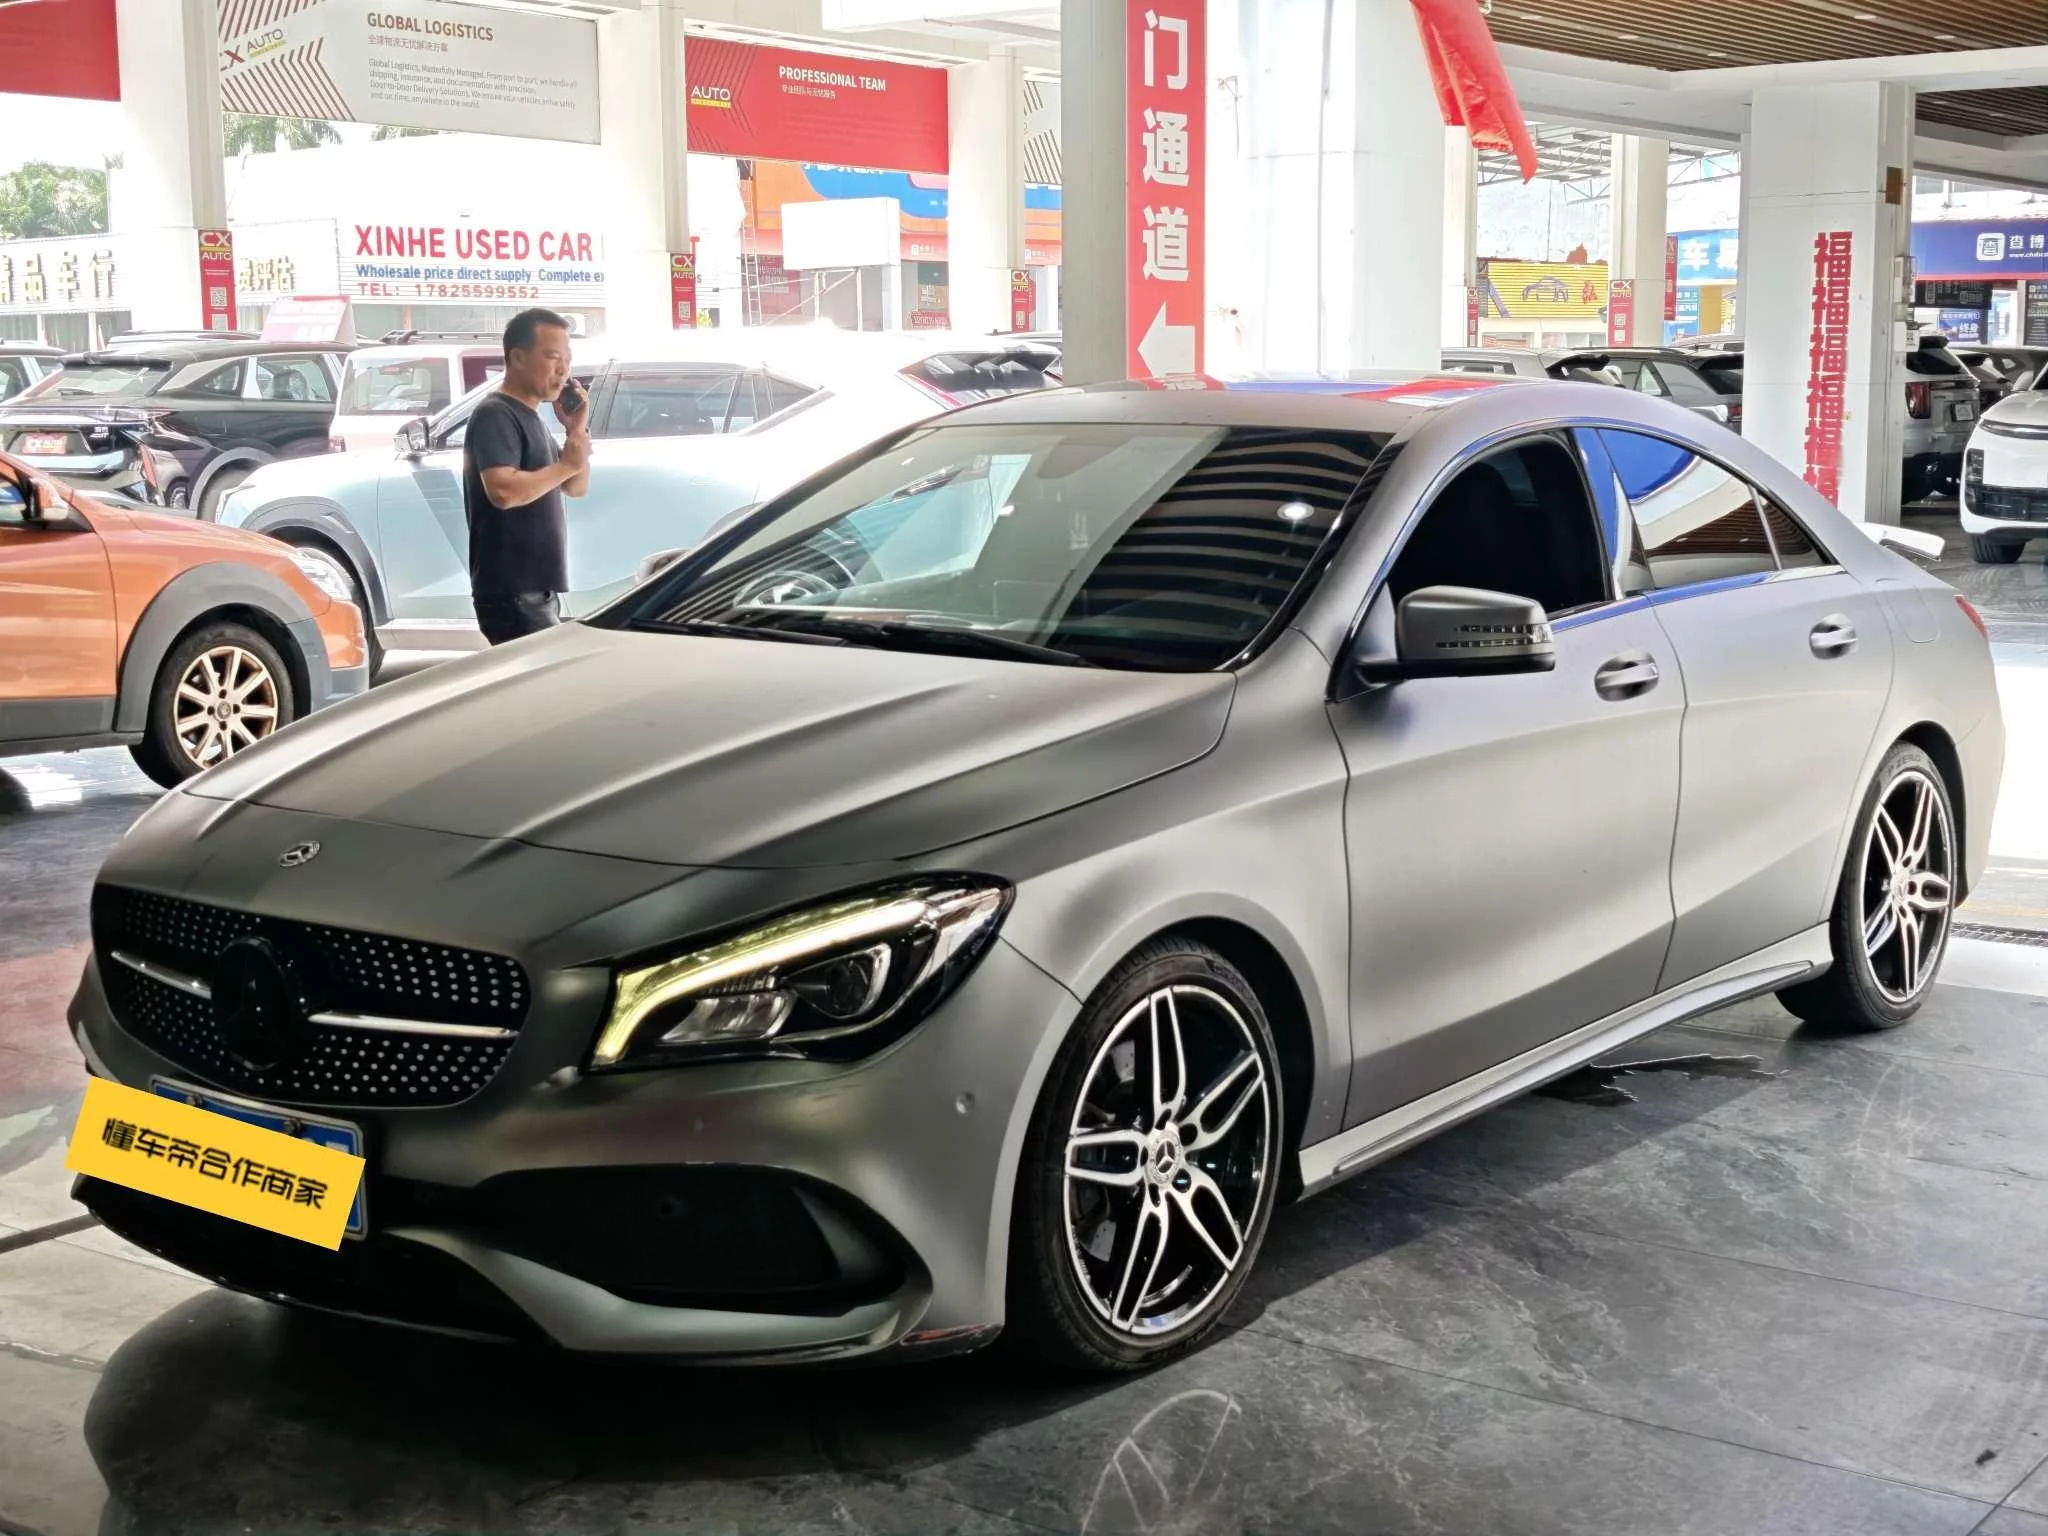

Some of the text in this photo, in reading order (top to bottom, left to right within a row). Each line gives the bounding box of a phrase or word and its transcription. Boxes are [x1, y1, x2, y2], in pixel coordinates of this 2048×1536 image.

[367, 12, 494, 42] GLOBAL LOGISTICS
[247, 28, 284, 53] AUTO
[778, 65, 888, 92] PROFESSIONAL TEAM
[690, 85, 731, 101] AUTO
[1143, 9, 1190, 282] 门通道
[200, 231, 231, 247] CX
[354, 224, 593, 262] XINHE USED CAR
[202, 252, 232, 261] AUTO
[672, 255, 694, 268] CX
[355, 263, 422, 280] Wholesale
[423, 265, 454, 281] price
[456, 266, 492, 281] direct
[494, 268, 532, 284] supply
[537, 268, 592, 284] Complete
[673, 271, 695, 279] AUTO
[1012, 271, 1029, 283] CX
[357, 282, 540, 300] TEL: 17825599552
[1013, 285, 1029, 293] AUTO
[1611, 280, 1633, 290] CX
